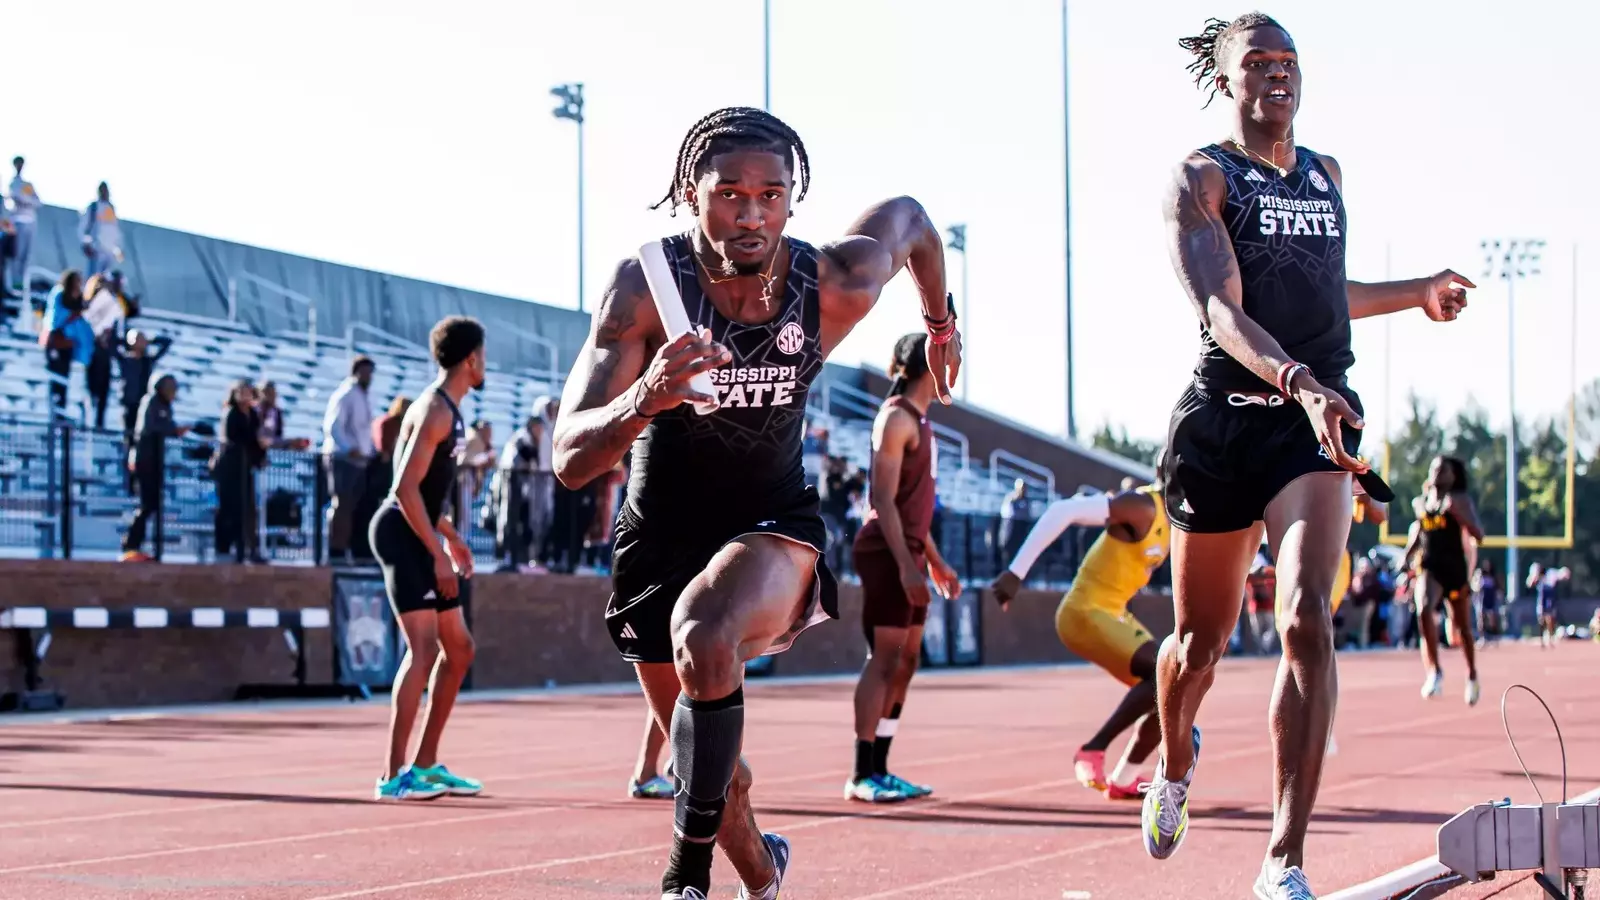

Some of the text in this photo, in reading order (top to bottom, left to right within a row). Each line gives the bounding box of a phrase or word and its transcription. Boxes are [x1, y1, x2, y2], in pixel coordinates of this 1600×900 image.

[1259, 195, 1333, 212] MISSISSIPPI
[1260, 209, 1339, 236] STATE
[779, 326, 801, 353] SEC
[708, 366, 797, 384] SSISSIPPI
[713, 381, 796, 408] ATE
